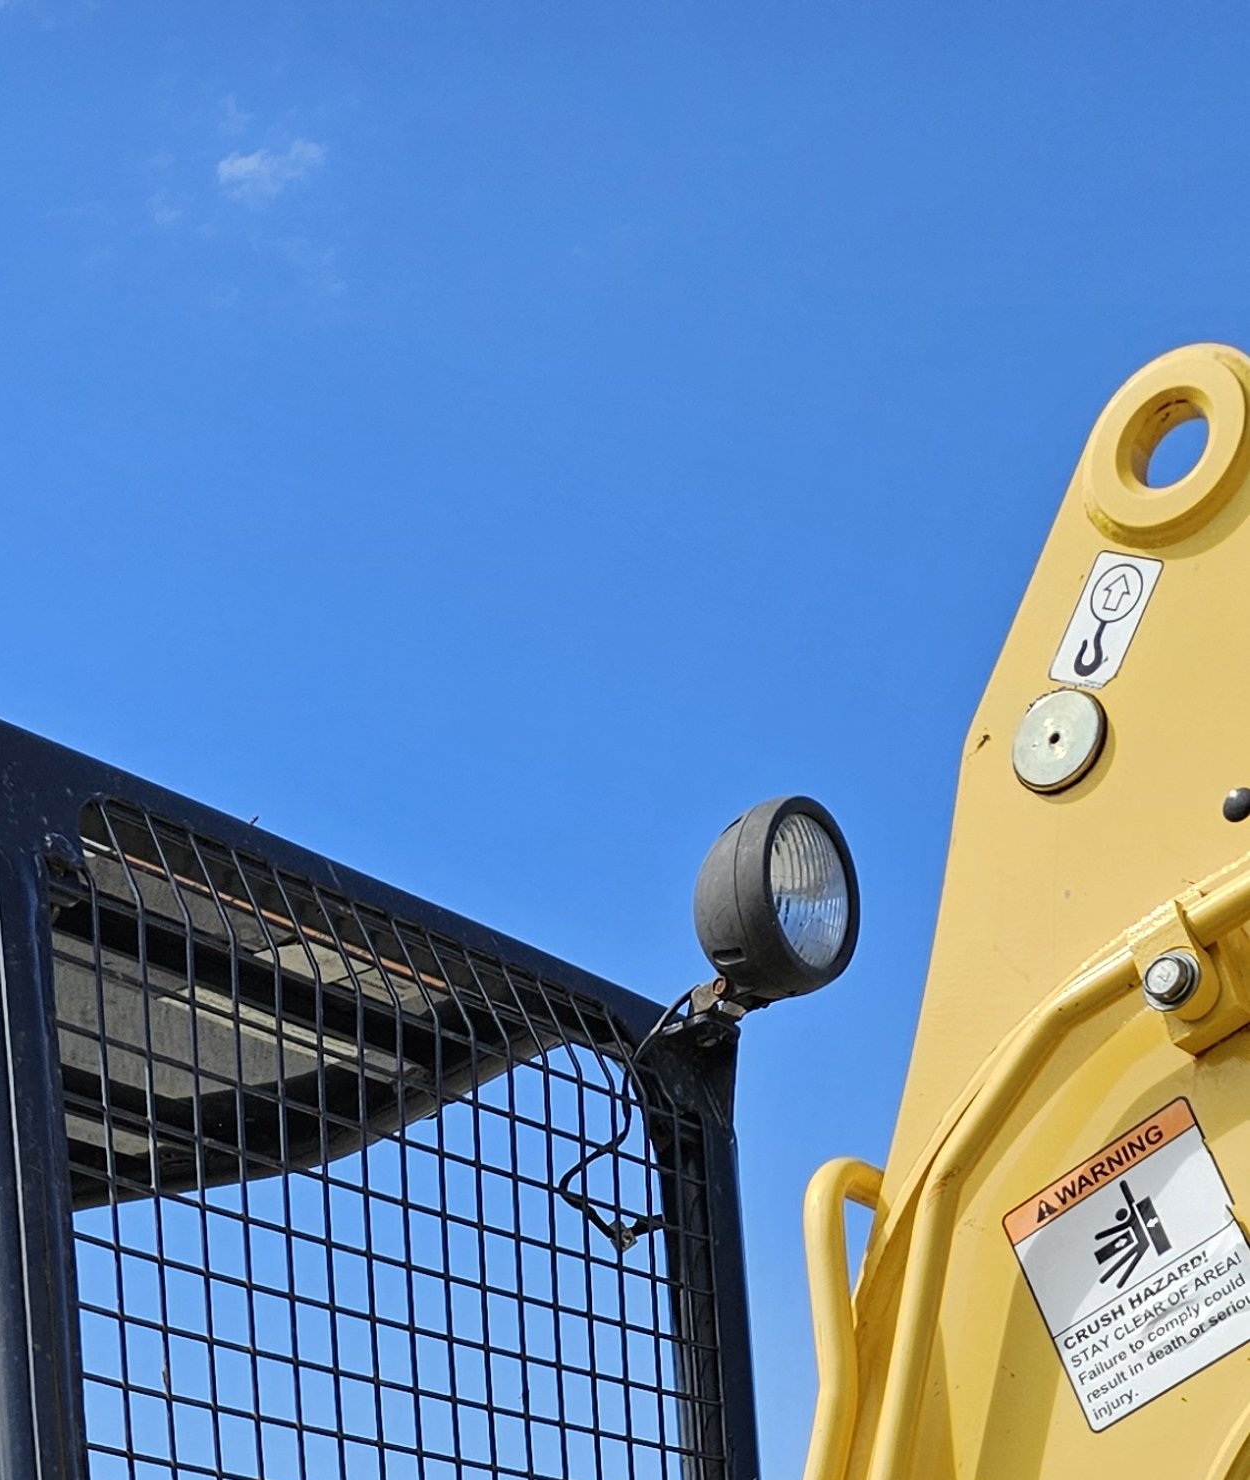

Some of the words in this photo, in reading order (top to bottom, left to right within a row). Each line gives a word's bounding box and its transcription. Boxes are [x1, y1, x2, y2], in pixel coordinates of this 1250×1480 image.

[1054, 1125, 1164, 1205] WARNING
[1064, 1304, 1126, 1350] CRUSH
[1129, 1250, 1209, 1310] HAZARD!
[1071, 1335, 1111, 1368] STAY
[1114, 1301, 1167, 1341] CLEAR
[1167, 1284, 1190, 1306] OF
[1193, 1251, 1242, 1291] AREA!
[1078, 1350, 1127, 1386] Failure
[1128, 1339, 1145, 1354] to
[1147, 1303, 1200, 1343] comply
[1204, 1273, 1246, 1307] could
[1086, 1371, 1129, 1403] result
[1129, 1362, 1145, 1377] in
[1146, 1334, 1187, 1365] death
[1190, 1323, 1206, 1339] or
[1092, 1388, 1139, 1421] injury.
